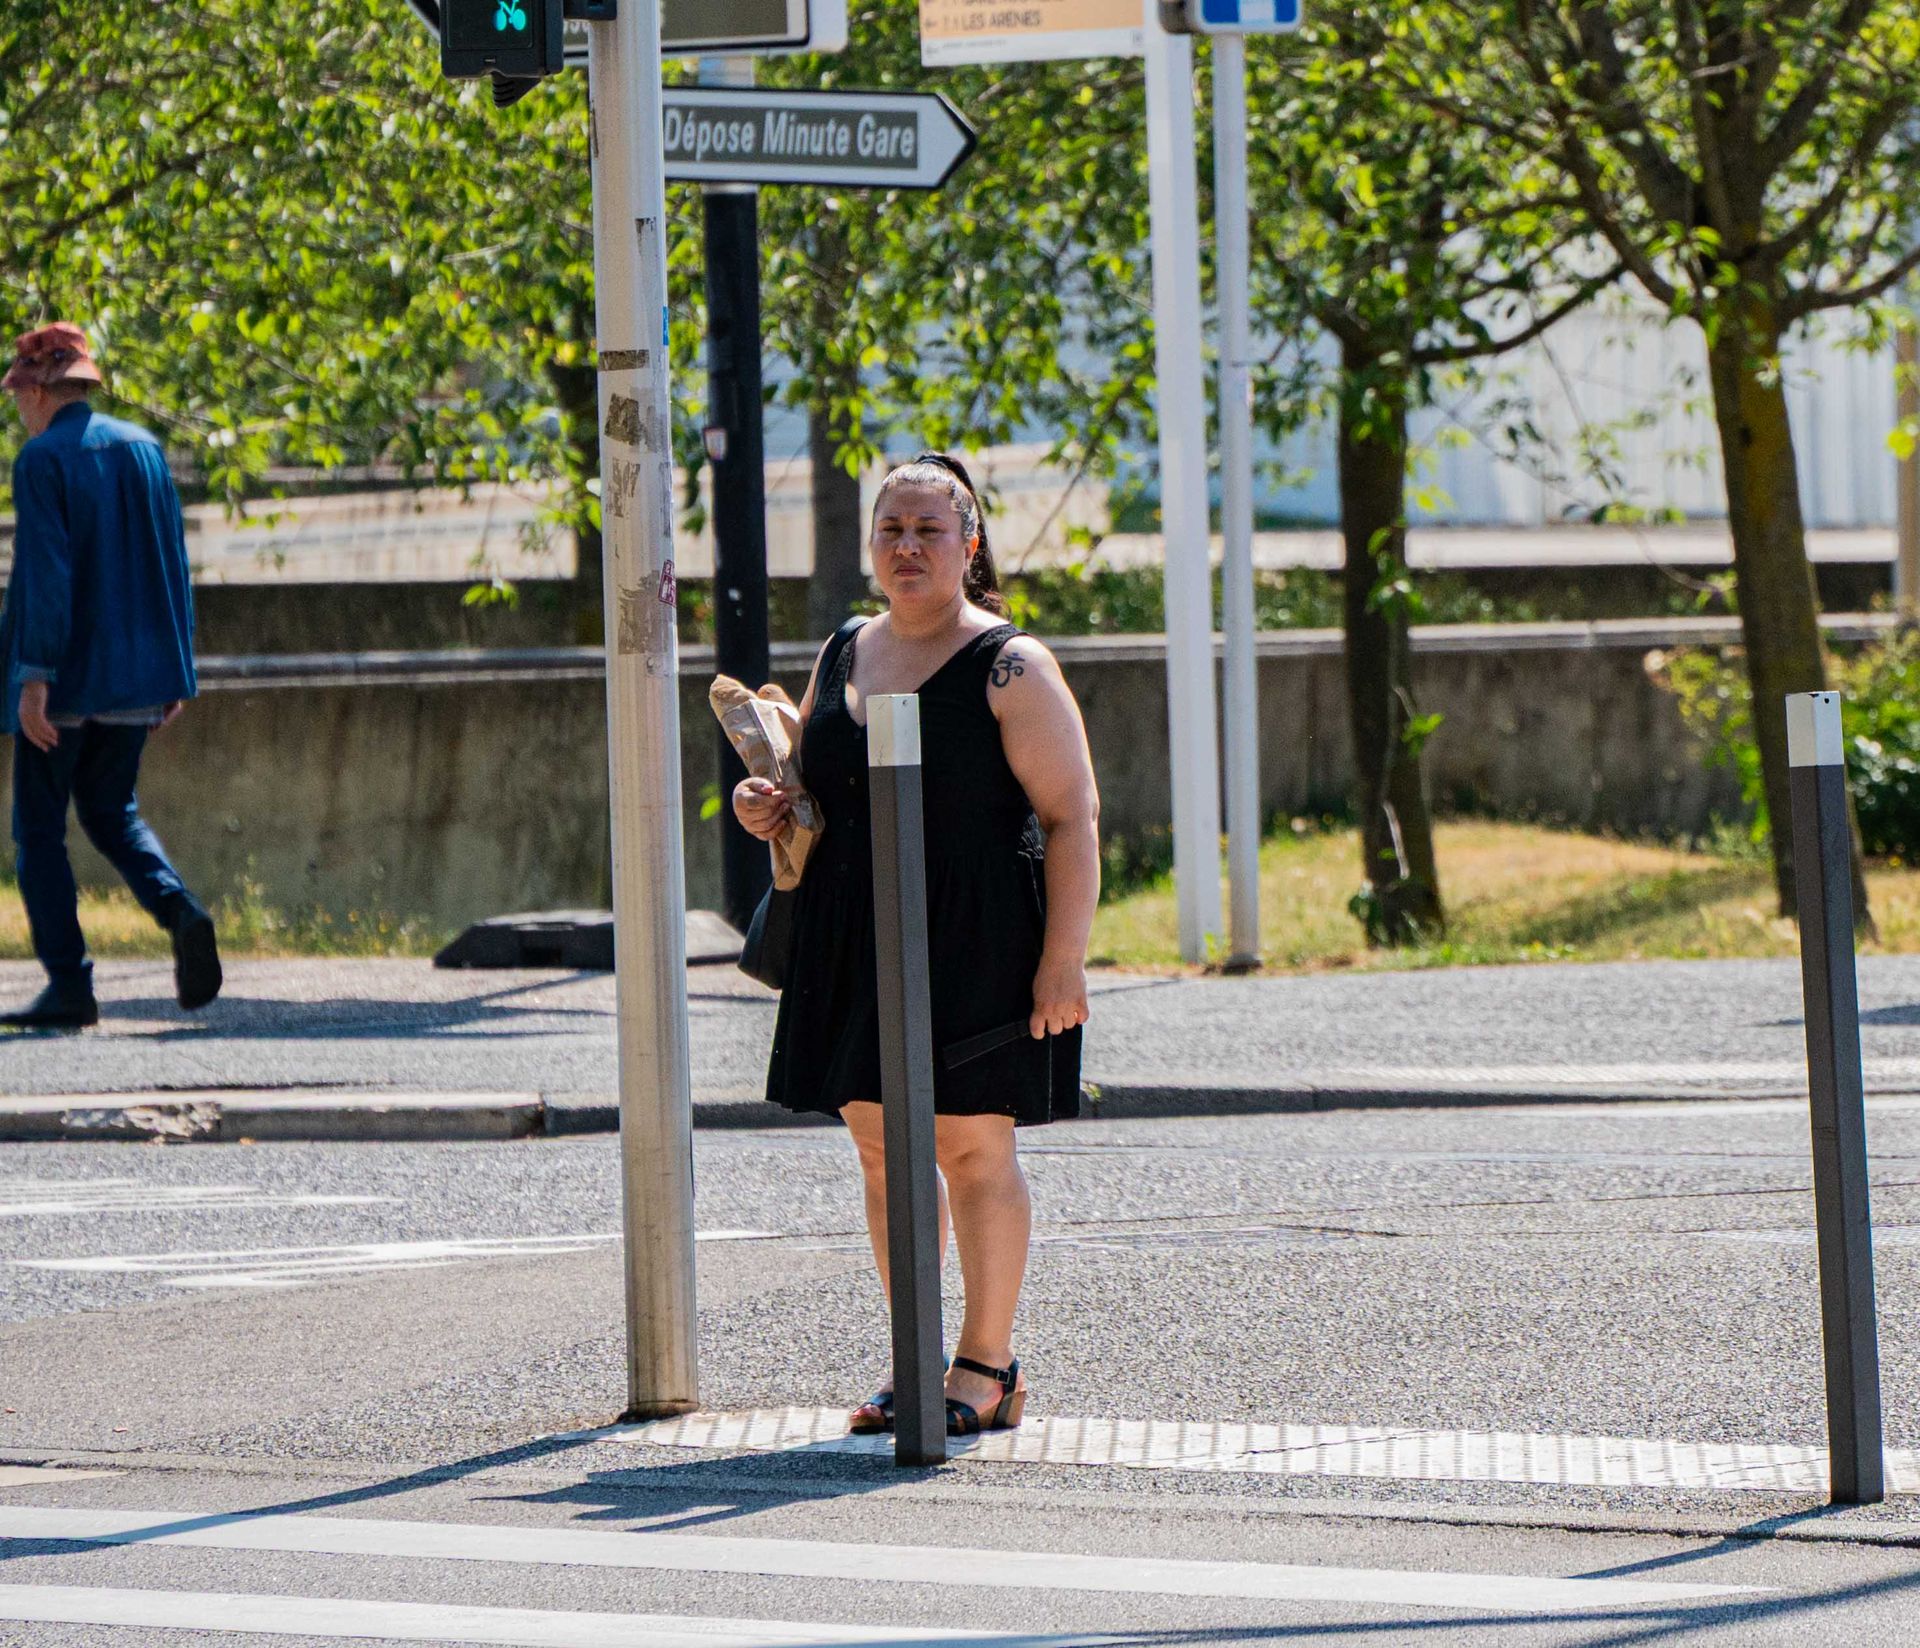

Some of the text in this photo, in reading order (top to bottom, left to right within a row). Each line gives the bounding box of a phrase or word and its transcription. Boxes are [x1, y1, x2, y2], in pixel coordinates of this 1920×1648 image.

[961, 12, 985, 31] LES
[664, 107, 917, 161] Dépose Minute Gare
